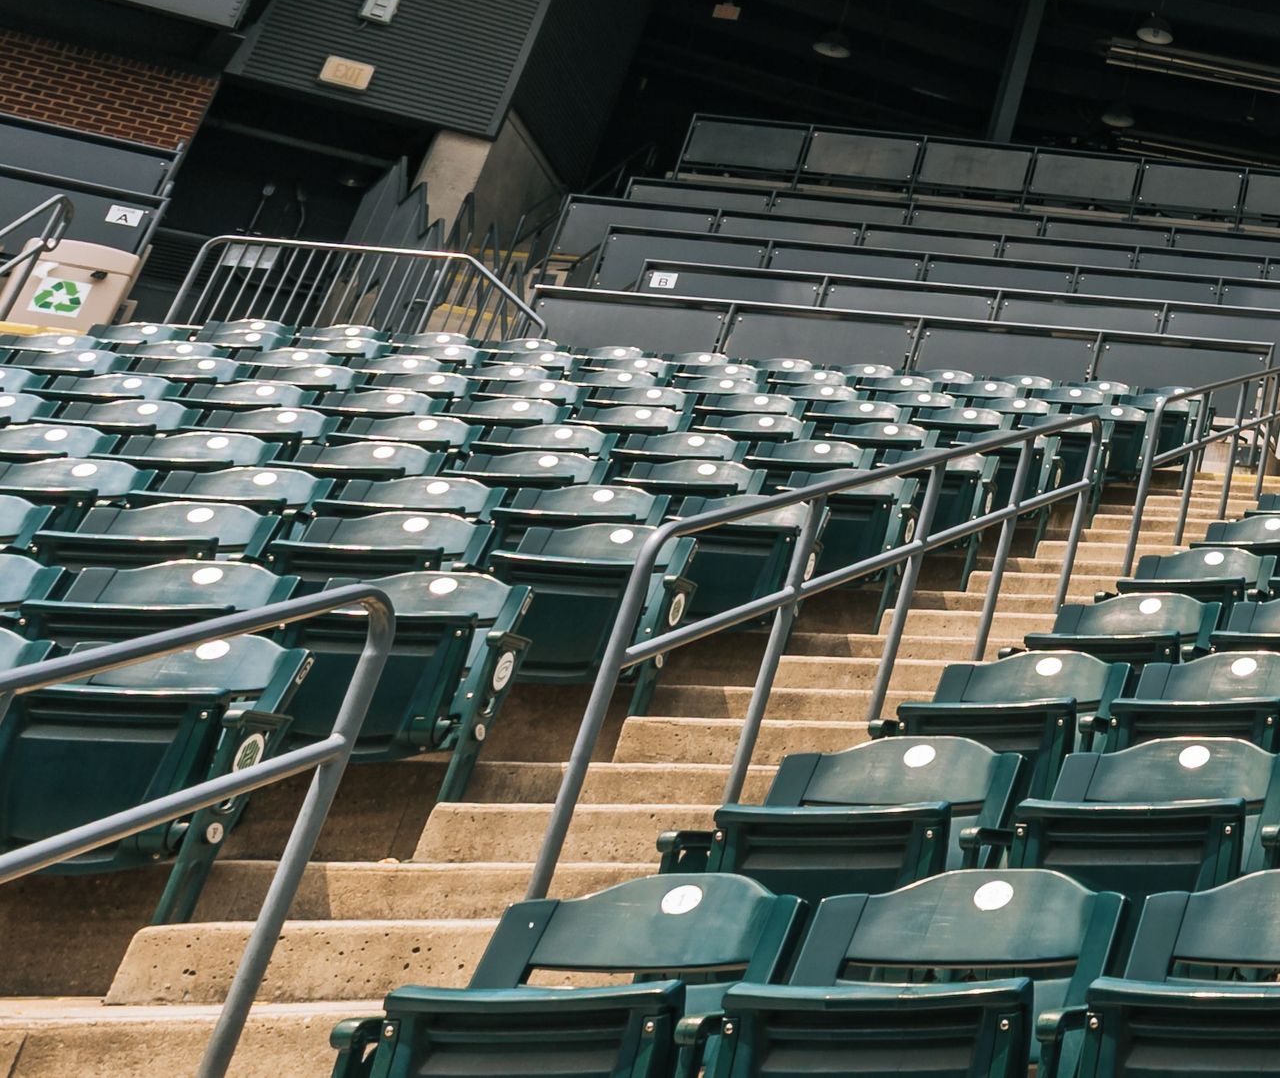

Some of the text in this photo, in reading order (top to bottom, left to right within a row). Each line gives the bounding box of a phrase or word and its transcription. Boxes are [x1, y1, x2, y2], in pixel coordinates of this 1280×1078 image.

[335, 62, 364, 83] EXIT
[115, 213, 128, 224] A
[658, 277, 669, 287] B
